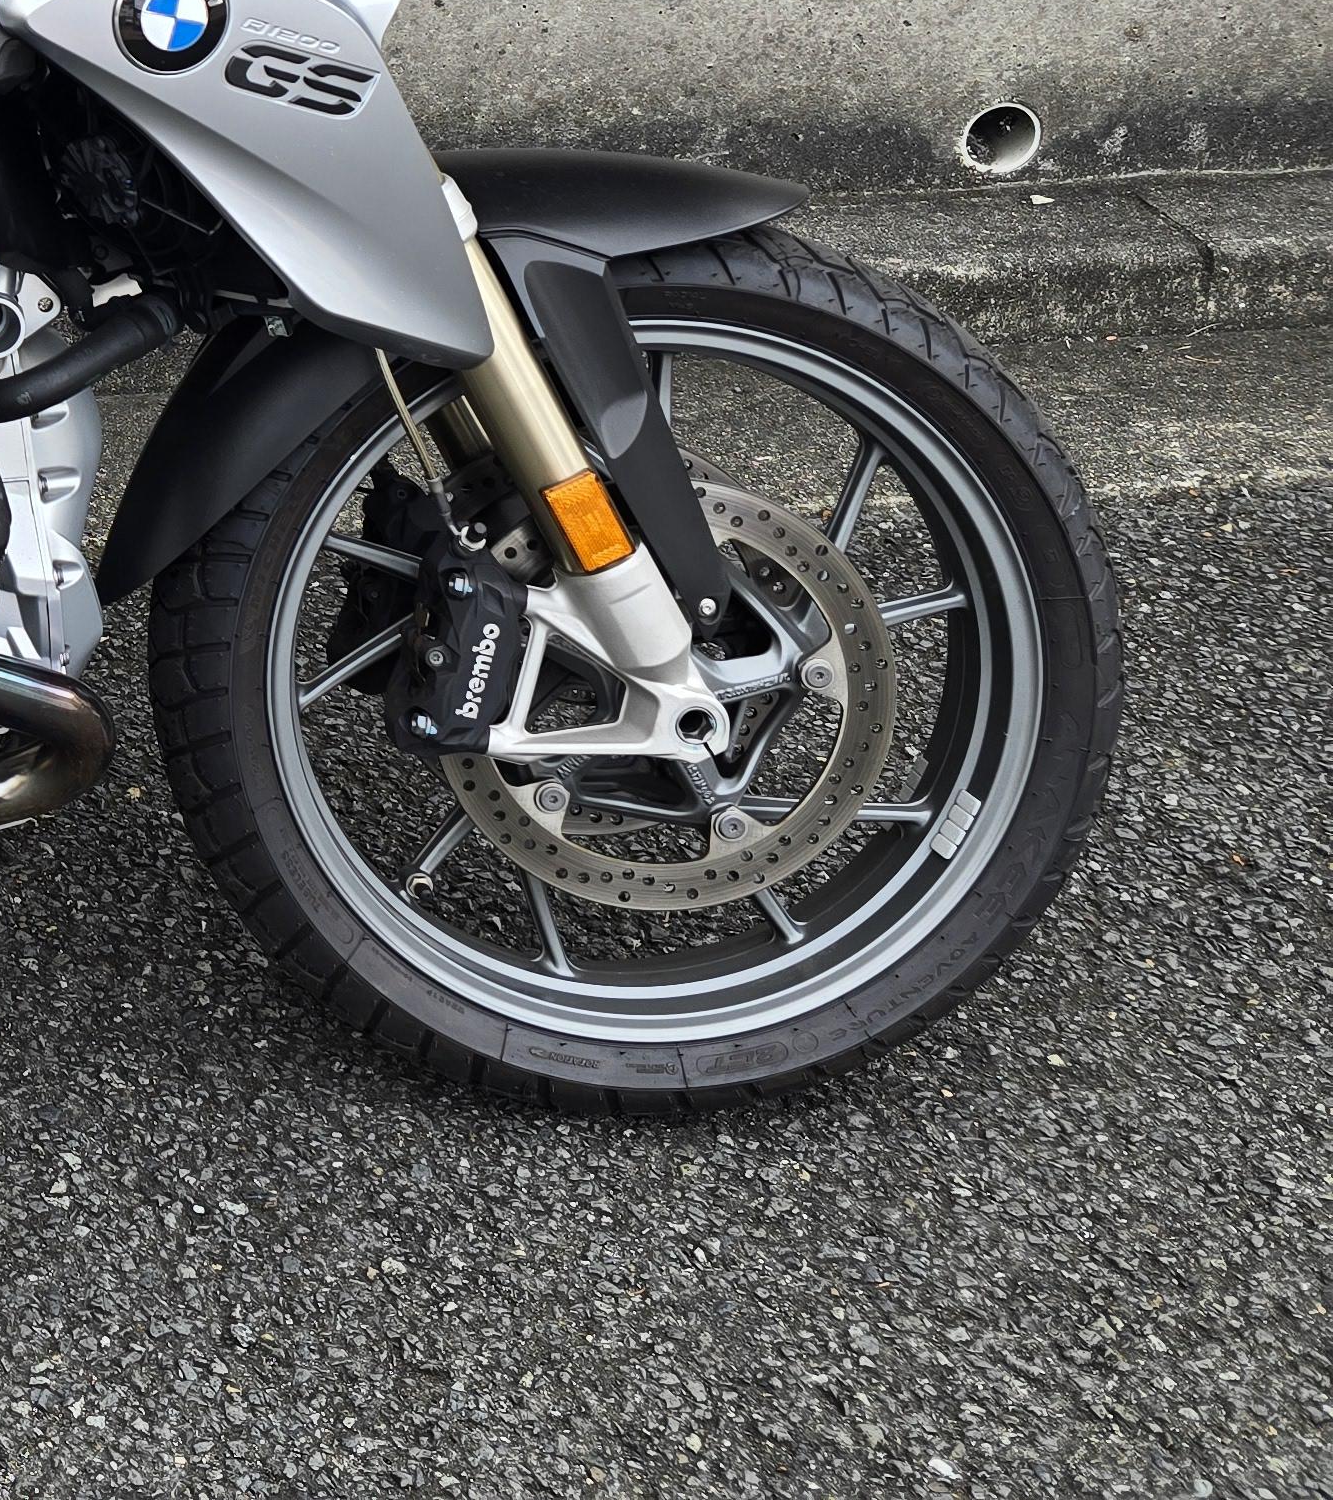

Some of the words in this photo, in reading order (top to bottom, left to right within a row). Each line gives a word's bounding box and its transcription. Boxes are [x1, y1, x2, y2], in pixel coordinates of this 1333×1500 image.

[224, 44, 381, 116] GS
[455, 623, 501, 720] brembo
[828, 929, 981, 1043] ADVENTURE
